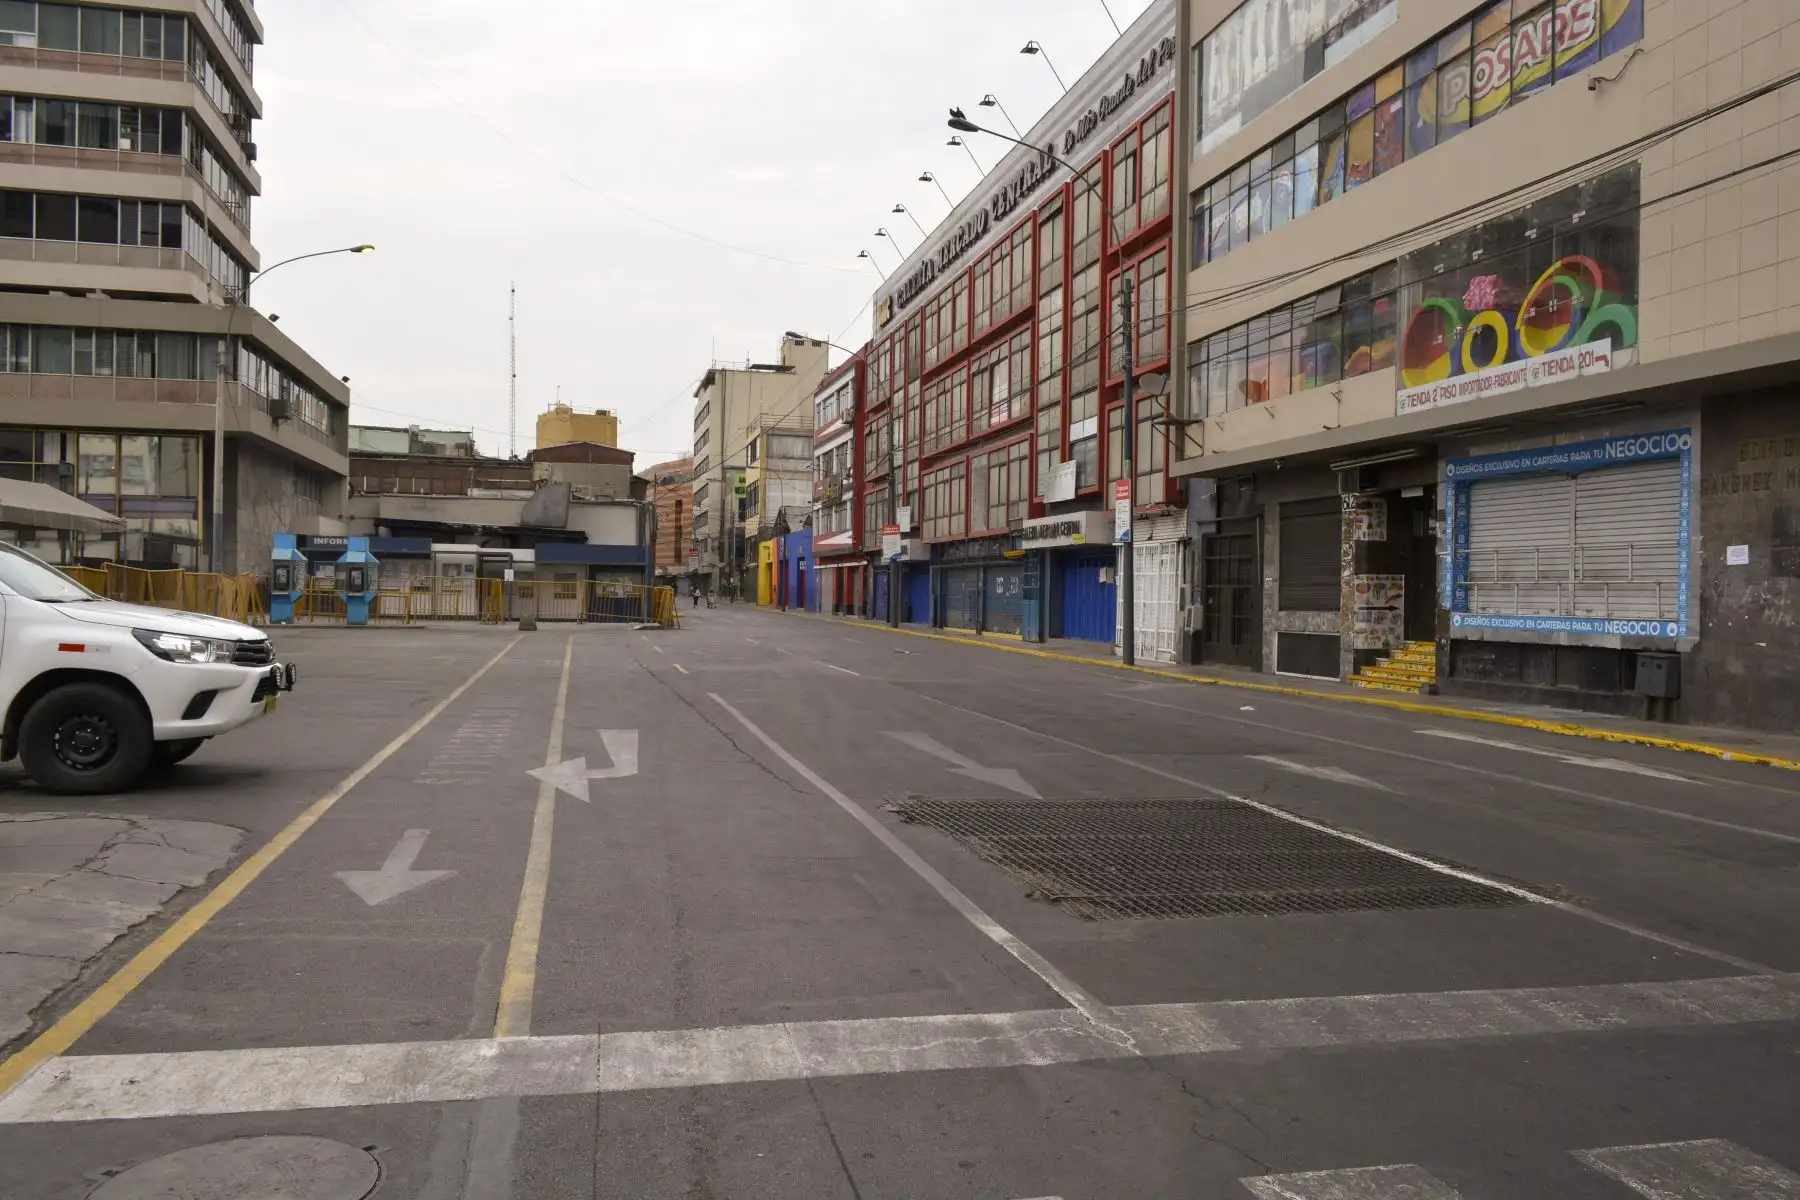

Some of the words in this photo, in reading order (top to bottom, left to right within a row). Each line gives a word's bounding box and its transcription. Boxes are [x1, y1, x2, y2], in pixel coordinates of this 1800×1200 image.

[936, 208, 989, 273] MERCADO
[992, 143, 1057, 221] CENTRAL
[1099, 73, 1135, 122] Grande
[1136, 47, 1157, 88] del
[1541, 355, 1576, 377] TIENDA
[1578, 349, 1595, 369] 201
[1406, 391, 1431, 408] TIENDA
[1440, 384, 1457, 401] PISO
[1456, 462, 1483, 475] DISEÑOS
[1484, 459, 1520, 472] EXCLUSIVO
[1522, 458, 1531, 468] EN
[1532, 453, 1569, 466] CARTERAS
[1570, 451, 1592, 461] PARA
[1593, 449, 1603, 459] TU
[1604, 434, 1679, 459] NEGOCIO
[1463, 615, 1490, 626] DISEÑOS
[1491, 617, 1525, 629] EXCLUSIVO
[1526, 619, 1535, 629] EN
[1536, 619, 1571, 631] CARTERAS
[1572, 621, 1592, 631] PARA
[1593, 621, 1603, 632] TU
[1604, 620, 1661, 636] NEGOCIO
